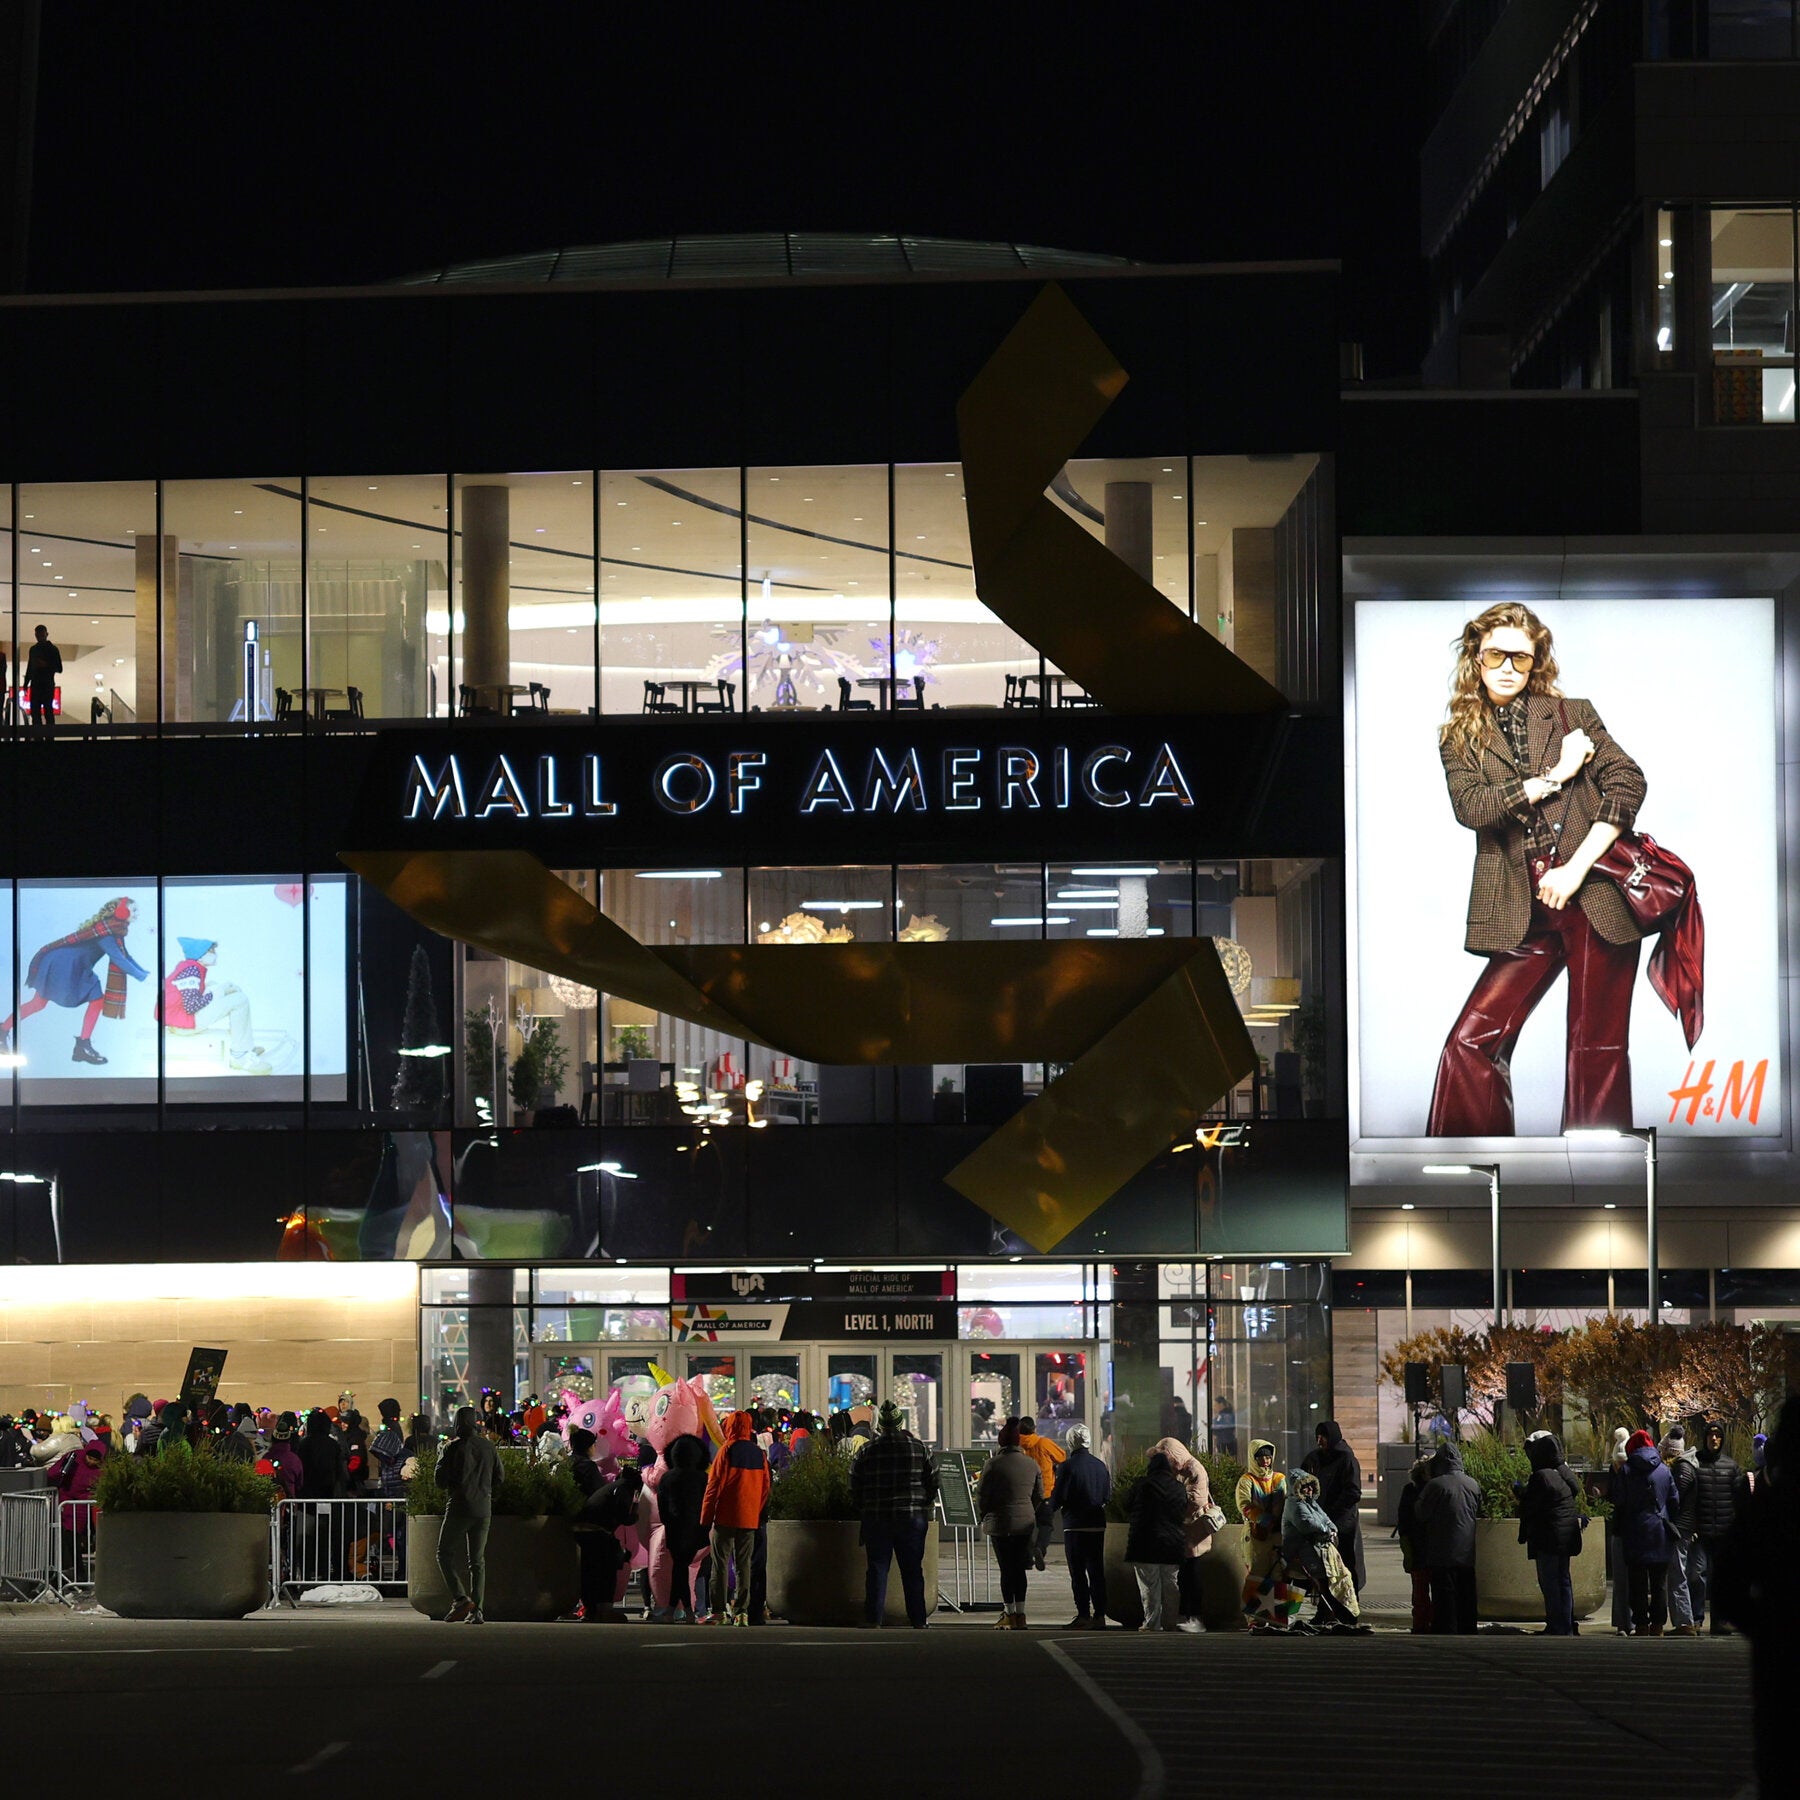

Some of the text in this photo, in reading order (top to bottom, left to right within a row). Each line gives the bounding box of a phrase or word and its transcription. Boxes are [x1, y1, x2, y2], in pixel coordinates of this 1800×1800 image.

[402, 741, 1196, 821] MALL OF AMERICA
[1667, 1058, 1769, 1126] H&M
[849, 1273, 911, 1282] OFFICIAL RIDE OF
[849, 1285, 867, 1293] MALL
[870, 1285, 879, 1293] OF
[731, 1321, 767, 1329] AMERICA
[844, 1314, 934, 1332] LEVEL 1, NORTH
